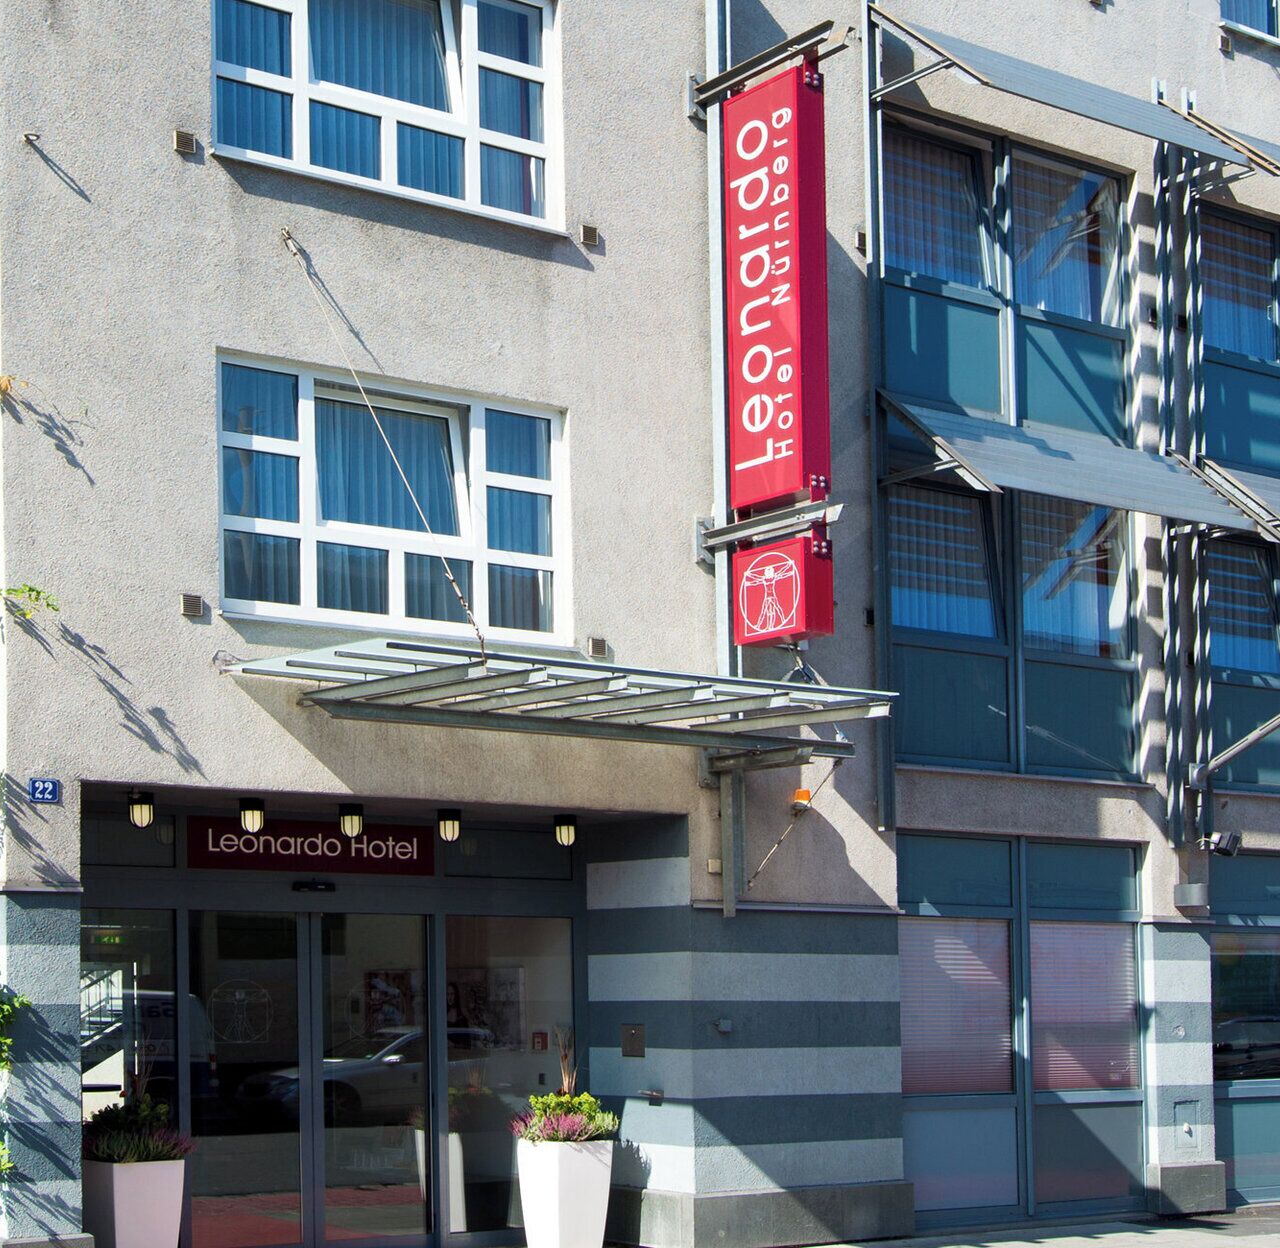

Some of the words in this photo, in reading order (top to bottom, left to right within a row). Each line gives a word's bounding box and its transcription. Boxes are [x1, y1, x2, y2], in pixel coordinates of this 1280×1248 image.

[770, 107, 792, 306] Nürnberg
[730, 119, 774, 471] Leonardo
[773, 347, 794, 459] Hotel
[34, 781, 53, 799] 22
[208, 827, 342, 857] Leonardo
[351, 834, 418, 860] Hotel
